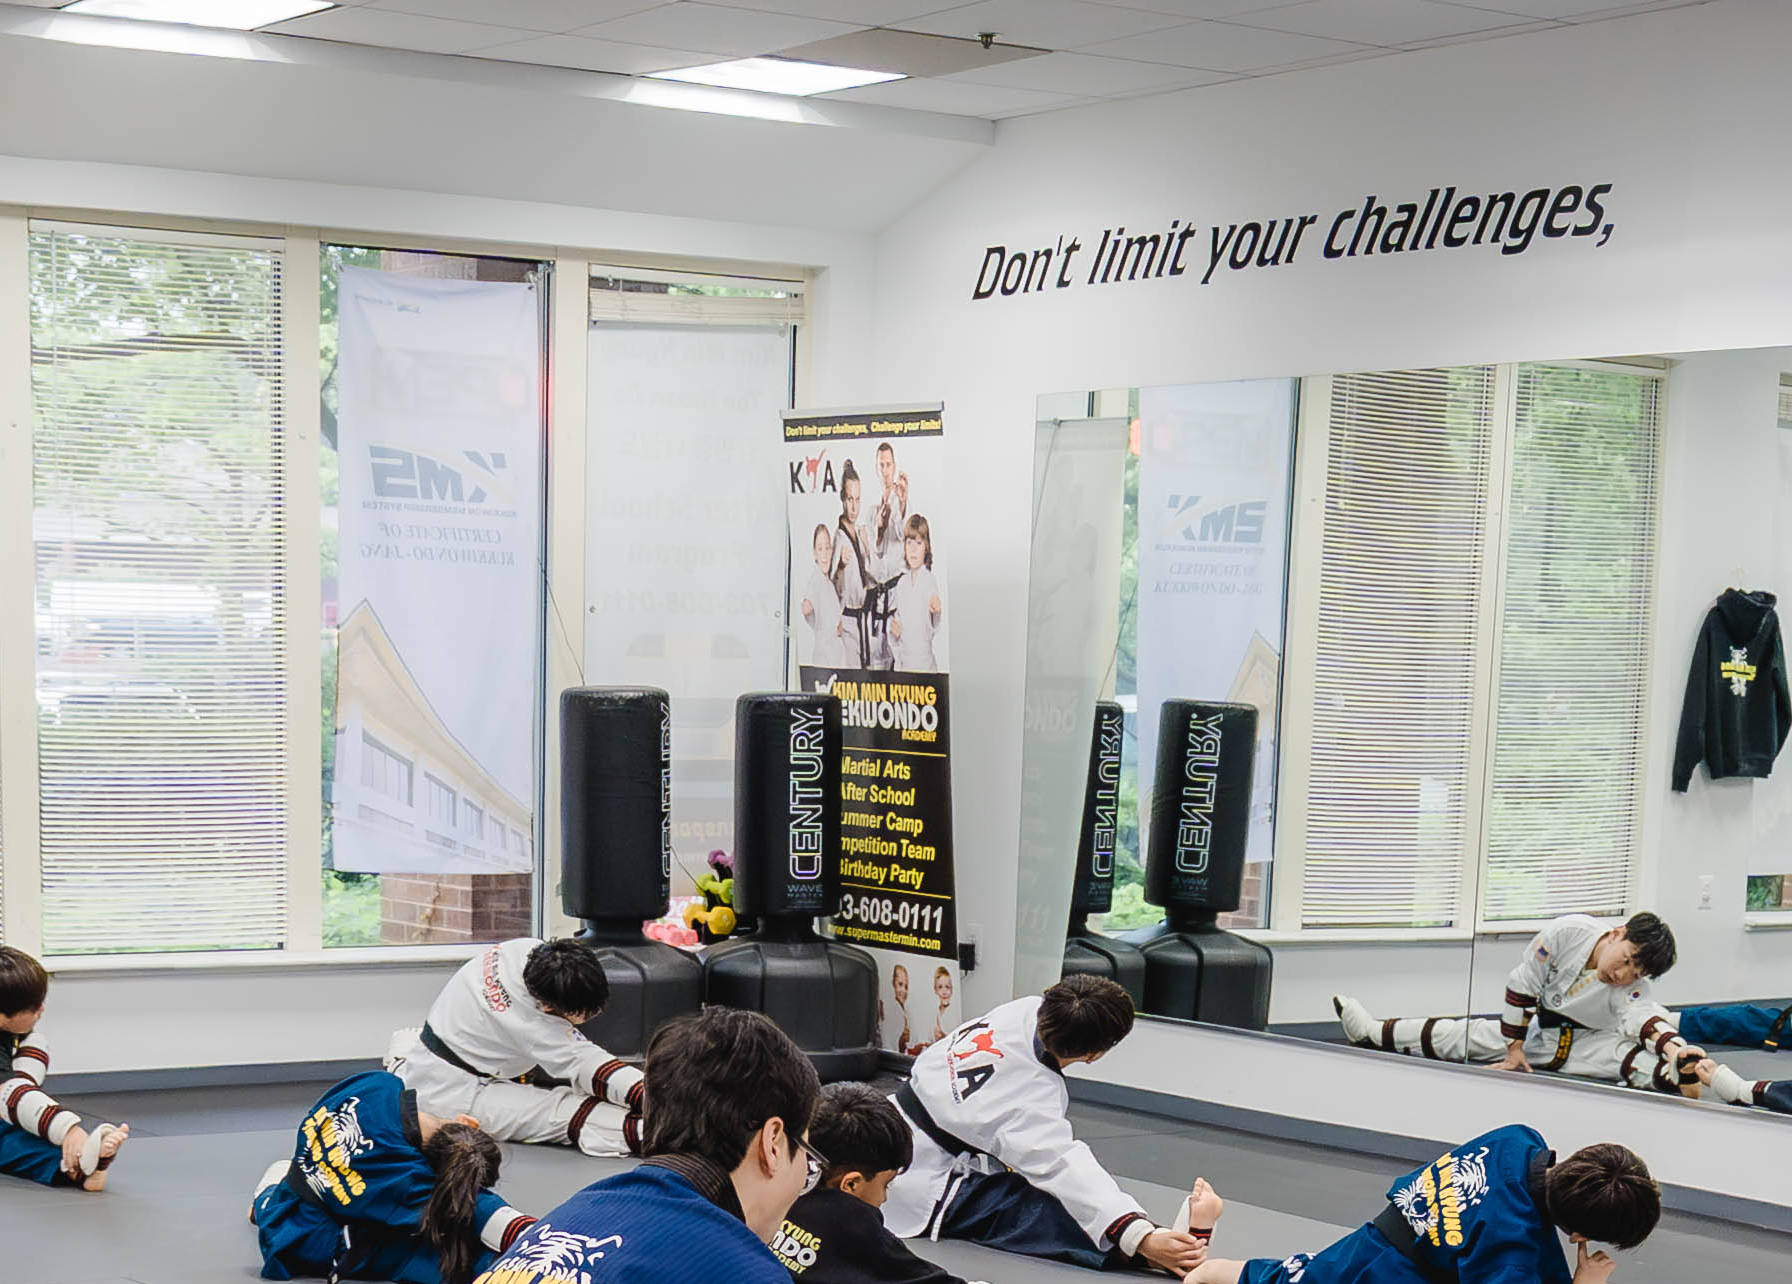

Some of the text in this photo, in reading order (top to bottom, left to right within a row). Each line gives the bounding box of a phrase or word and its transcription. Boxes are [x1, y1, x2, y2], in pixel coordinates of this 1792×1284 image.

[972, 183, 1613, 300] Don't limit your challenges,
[833, 681, 937, 706] KIM MIN KYUNG
[842, 700, 939, 731] EKWONDO
[883, 759, 911, 779] Arts
[870, 784, 916, 806] School
[841, 811, 924, 837] ummer Camp
[841, 835, 936, 861] mpetition Team
[890, 864, 924, 889] Party
[834, 893, 943, 934] 3-608-0111
